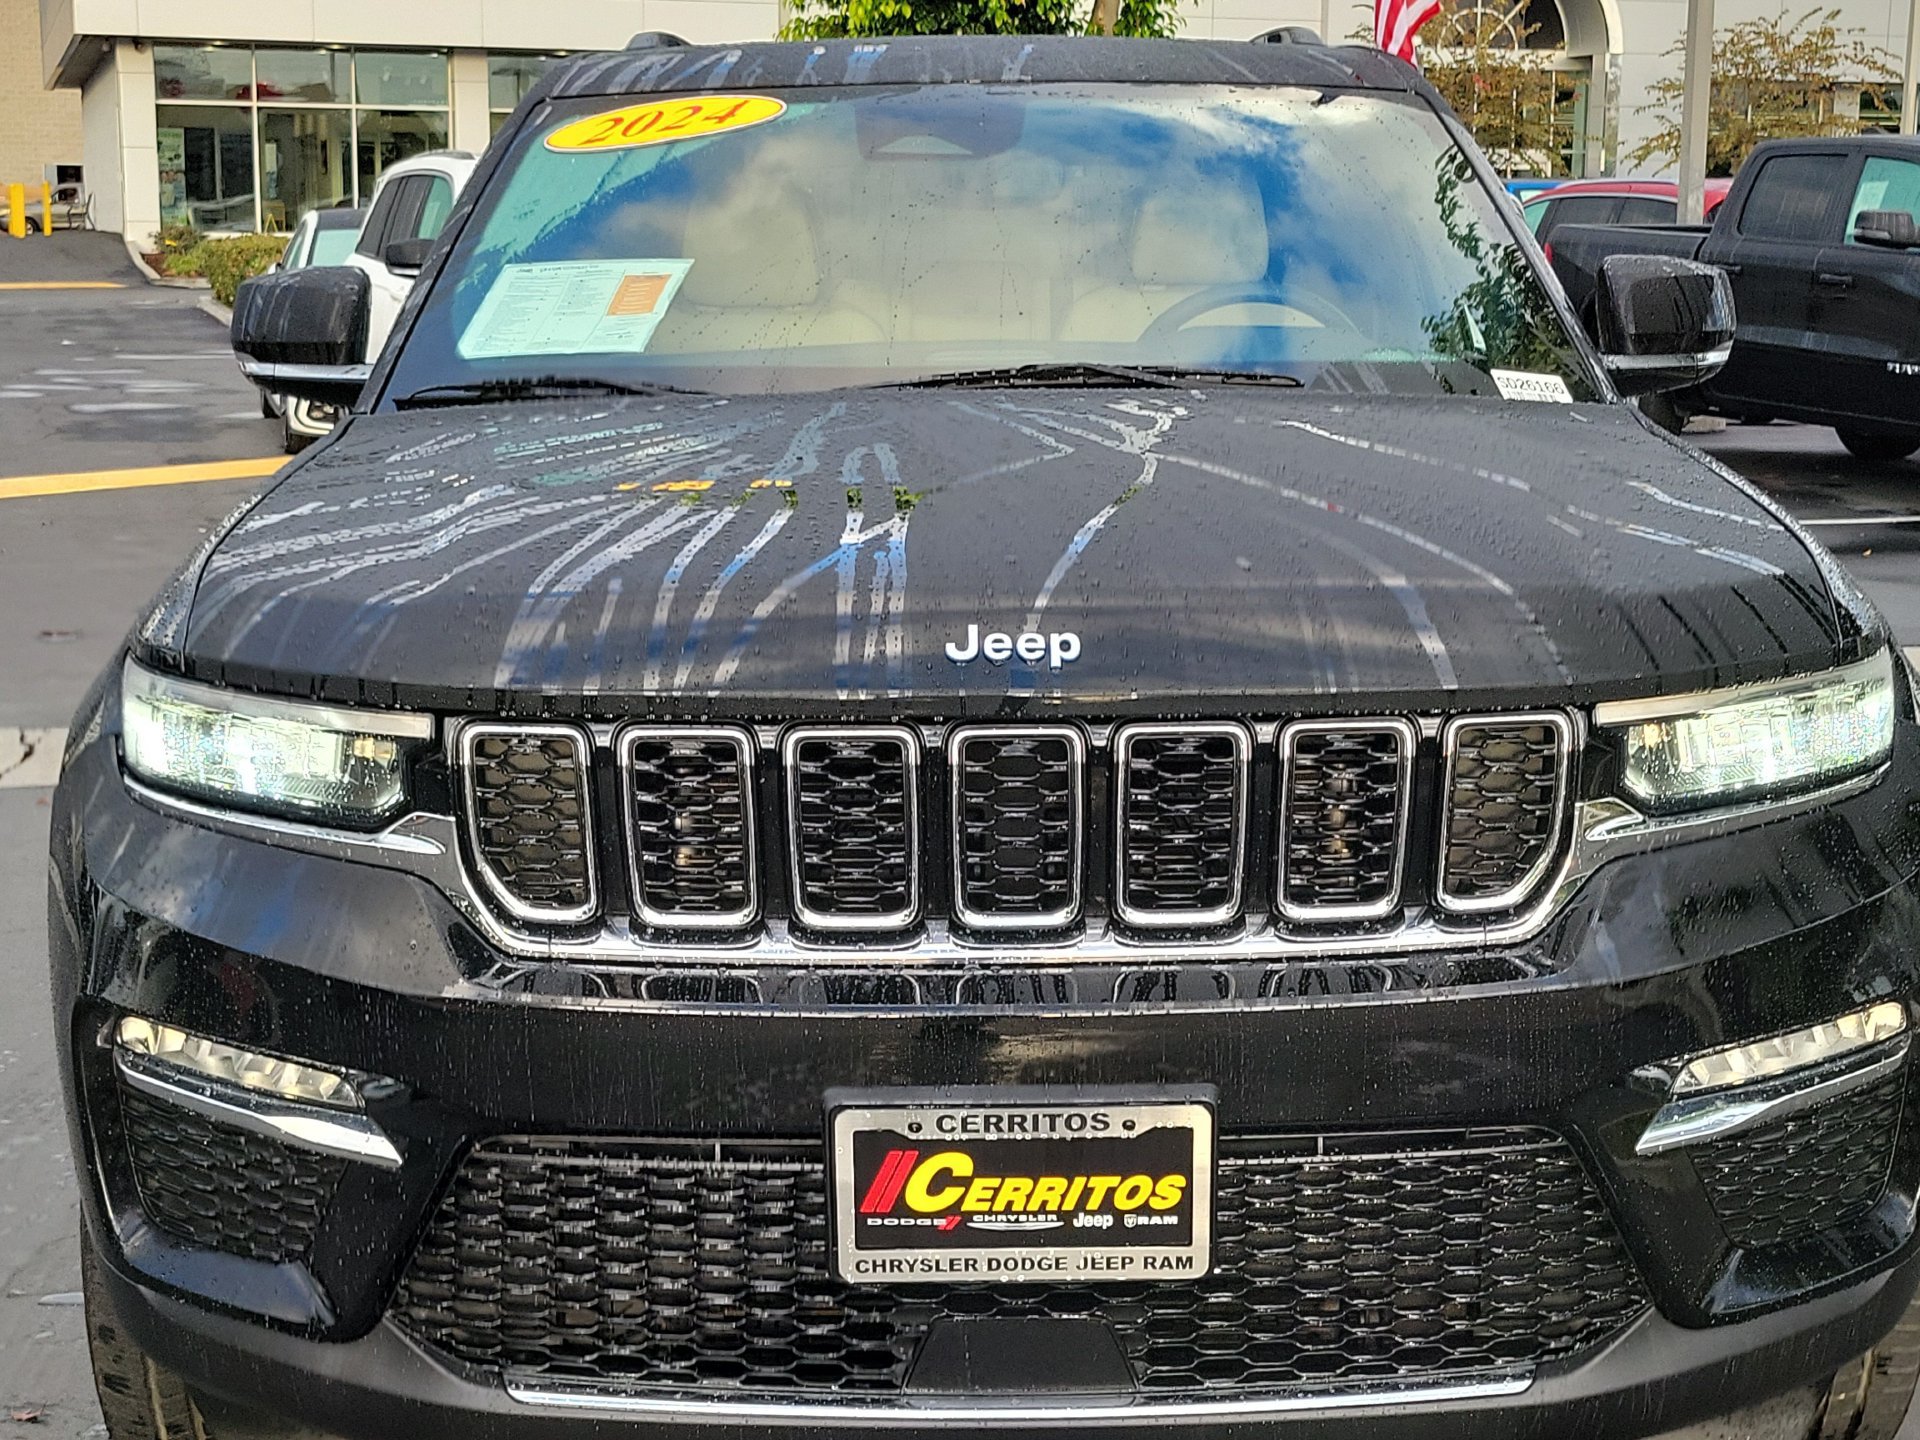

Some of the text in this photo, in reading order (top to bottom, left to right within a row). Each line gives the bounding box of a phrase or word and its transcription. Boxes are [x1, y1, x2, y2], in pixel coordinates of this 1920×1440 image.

[577, 100, 749, 145] 2024
[945, 624, 1081, 669] Jeep
[936, 1112, 1110, 1134] CERRITOS
[904, 1152, 1186, 1213] CERRITOS
[867, 1217, 947, 1226] DODGE
[972, 1214, 1058, 1222] CHRYSLER
[1073, 1212, 1114, 1230] Jeep
[1137, 1215, 1178, 1225] RAM
[855, 1255, 1194, 1274] CHRYSLER DODGE JEEP RAM
